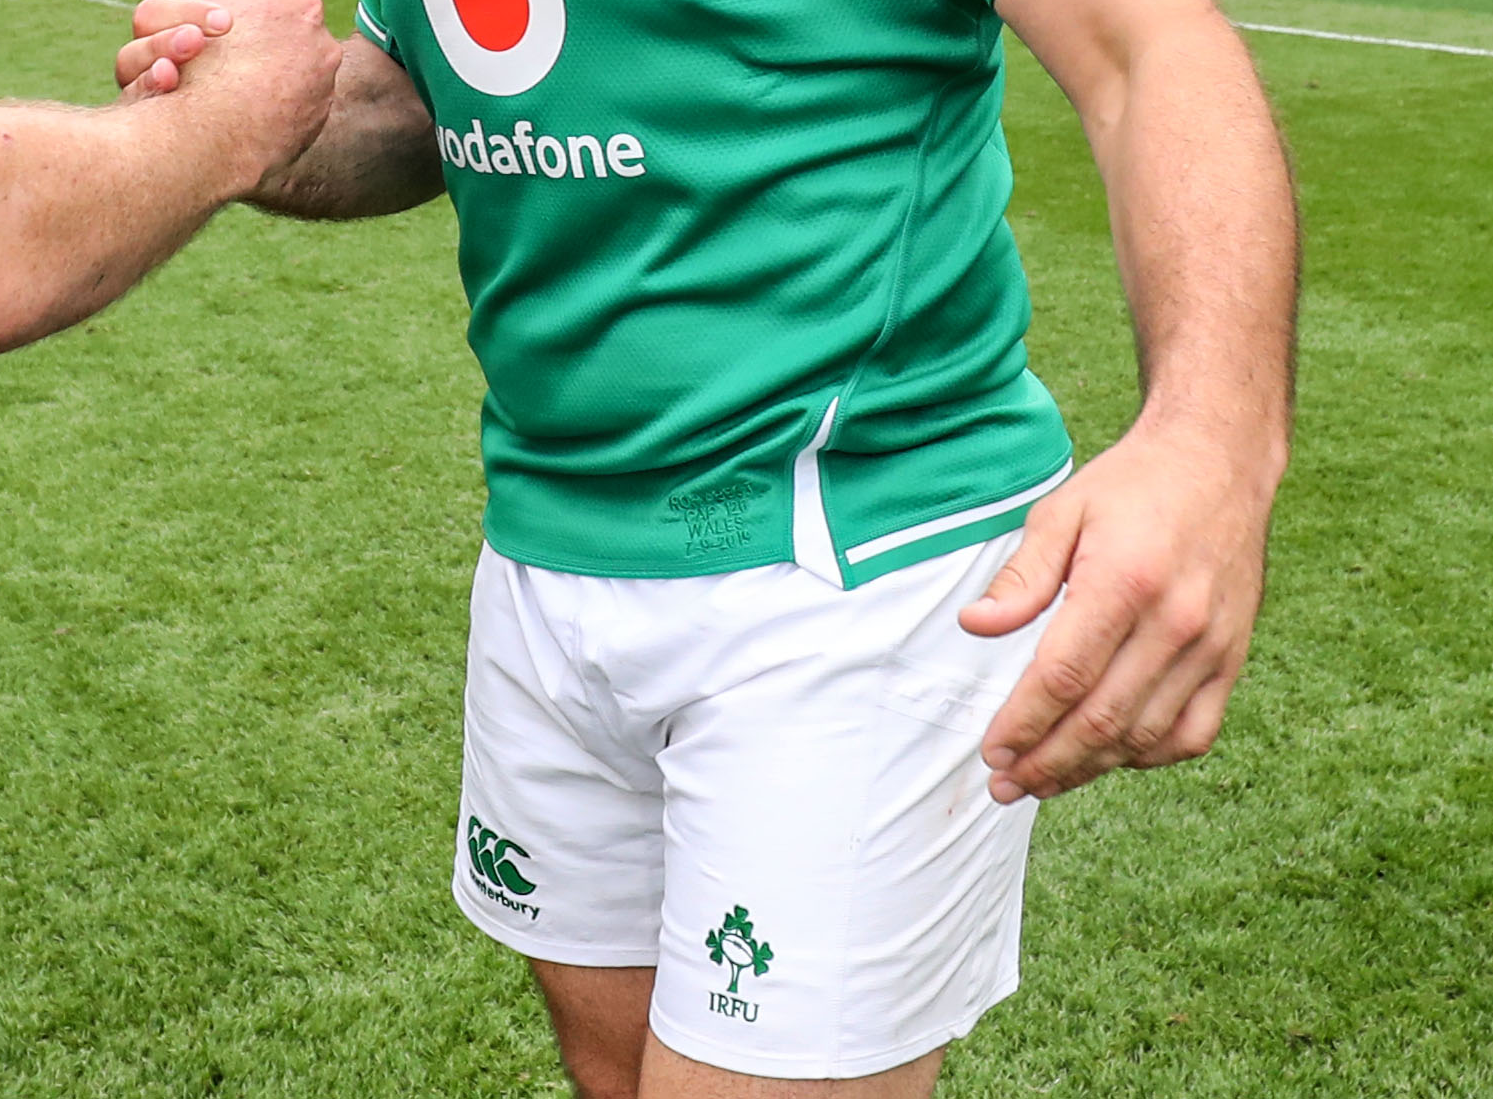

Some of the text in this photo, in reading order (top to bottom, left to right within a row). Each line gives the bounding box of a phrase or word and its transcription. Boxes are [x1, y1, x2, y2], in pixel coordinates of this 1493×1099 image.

[436, 118, 646, 179] vodafone
[687, 516, 744, 540] WALES
[709, 991, 759, 1023] IRFU
